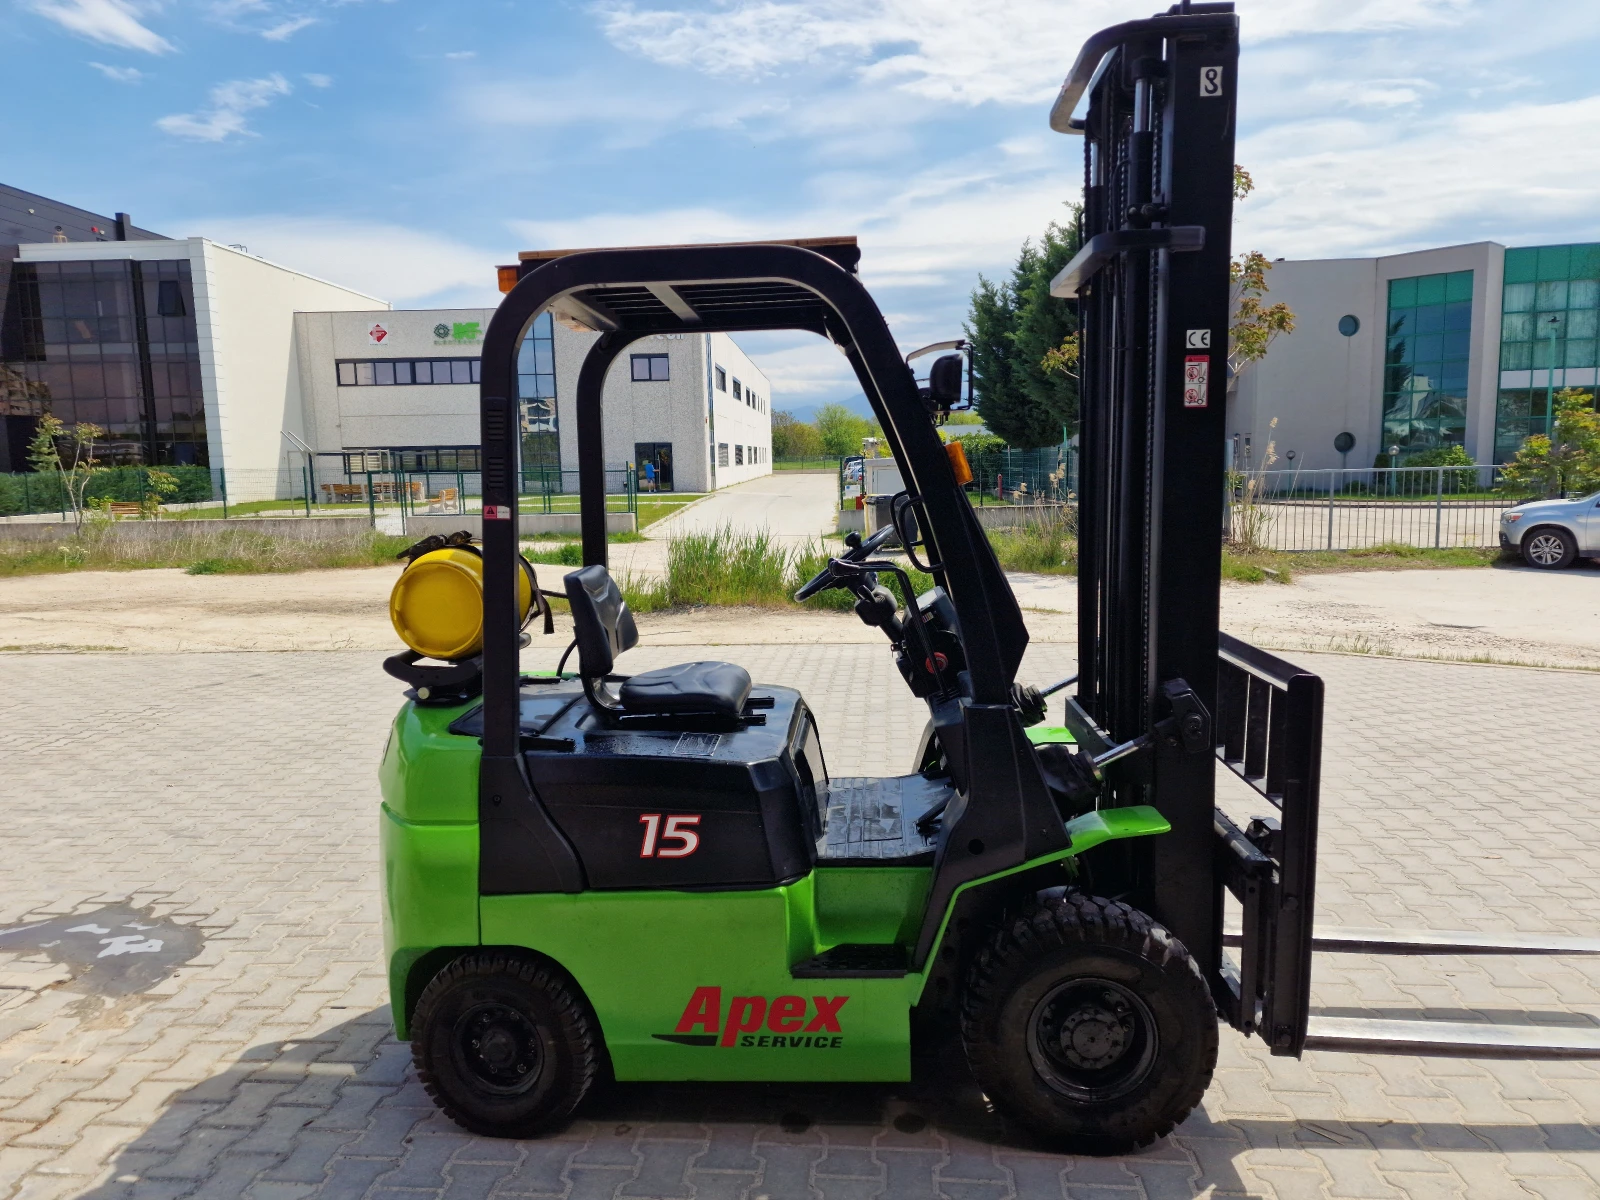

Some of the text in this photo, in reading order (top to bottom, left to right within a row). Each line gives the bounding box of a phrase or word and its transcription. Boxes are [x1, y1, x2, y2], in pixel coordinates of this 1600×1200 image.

[1188, 331, 1209, 347] CE
[639, 813, 701, 858] 15
[674, 986, 850, 1048] Apex
[741, 1035, 843, 1048] SERVICE
